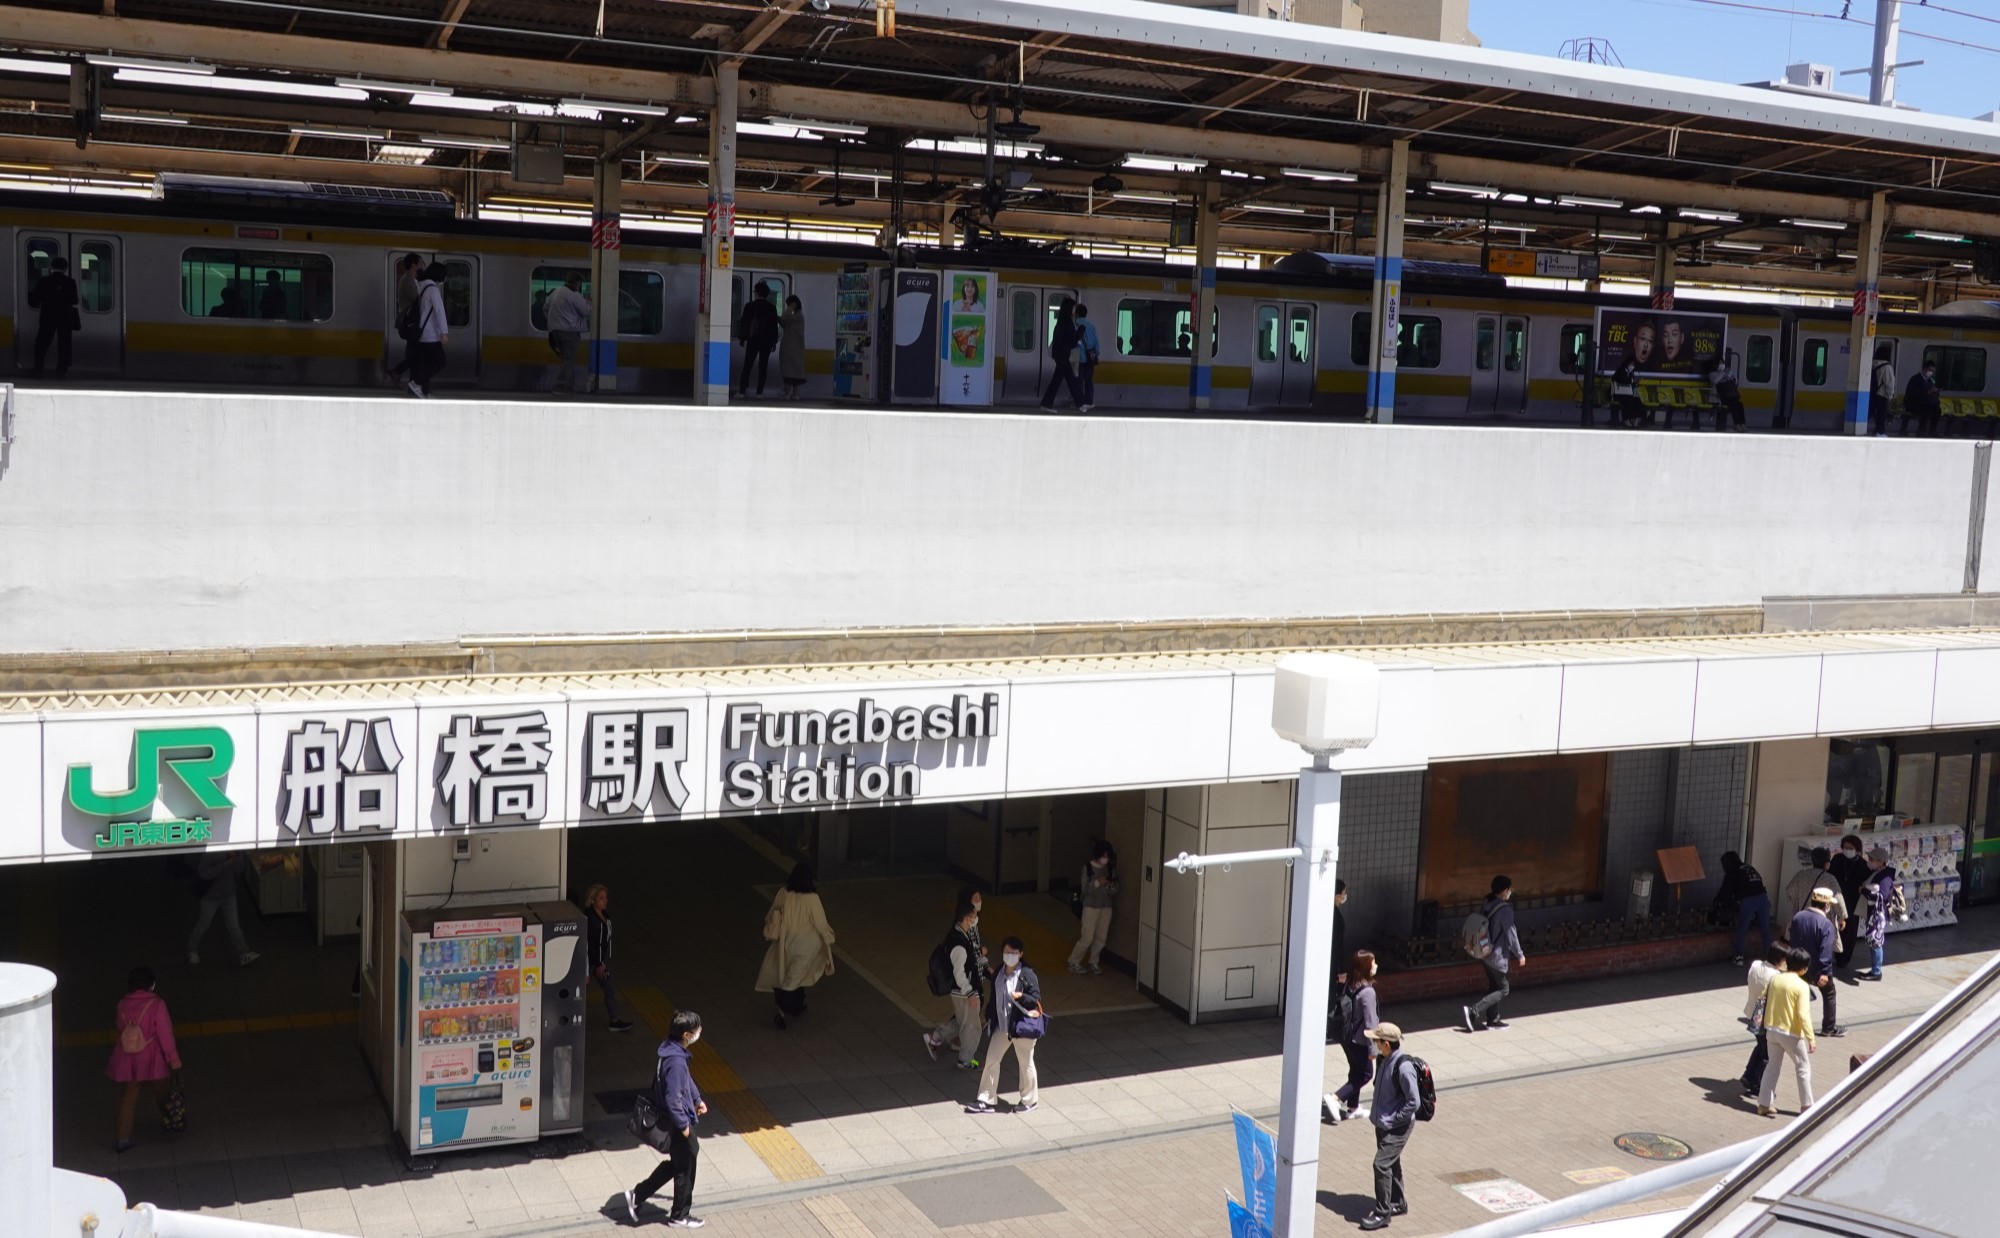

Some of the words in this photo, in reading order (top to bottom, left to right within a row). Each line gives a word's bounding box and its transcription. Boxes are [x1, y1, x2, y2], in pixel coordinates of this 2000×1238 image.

[906, 279, 930, 287] acure
[1608, 330, 1629, 343] TBC
[1695, 338, 1717, 353] 98%
[726, 692, 999, 750] Funabashi
[66, 725, 237, 816] JR
[280, 708, 691, 835] 船橋駅
[725, 753, 921, 809] Station
[95, 816, 213, 848] JR東日本
[553, 924, 578, 933] acure
[490, 1069, 532, 1081] acure
